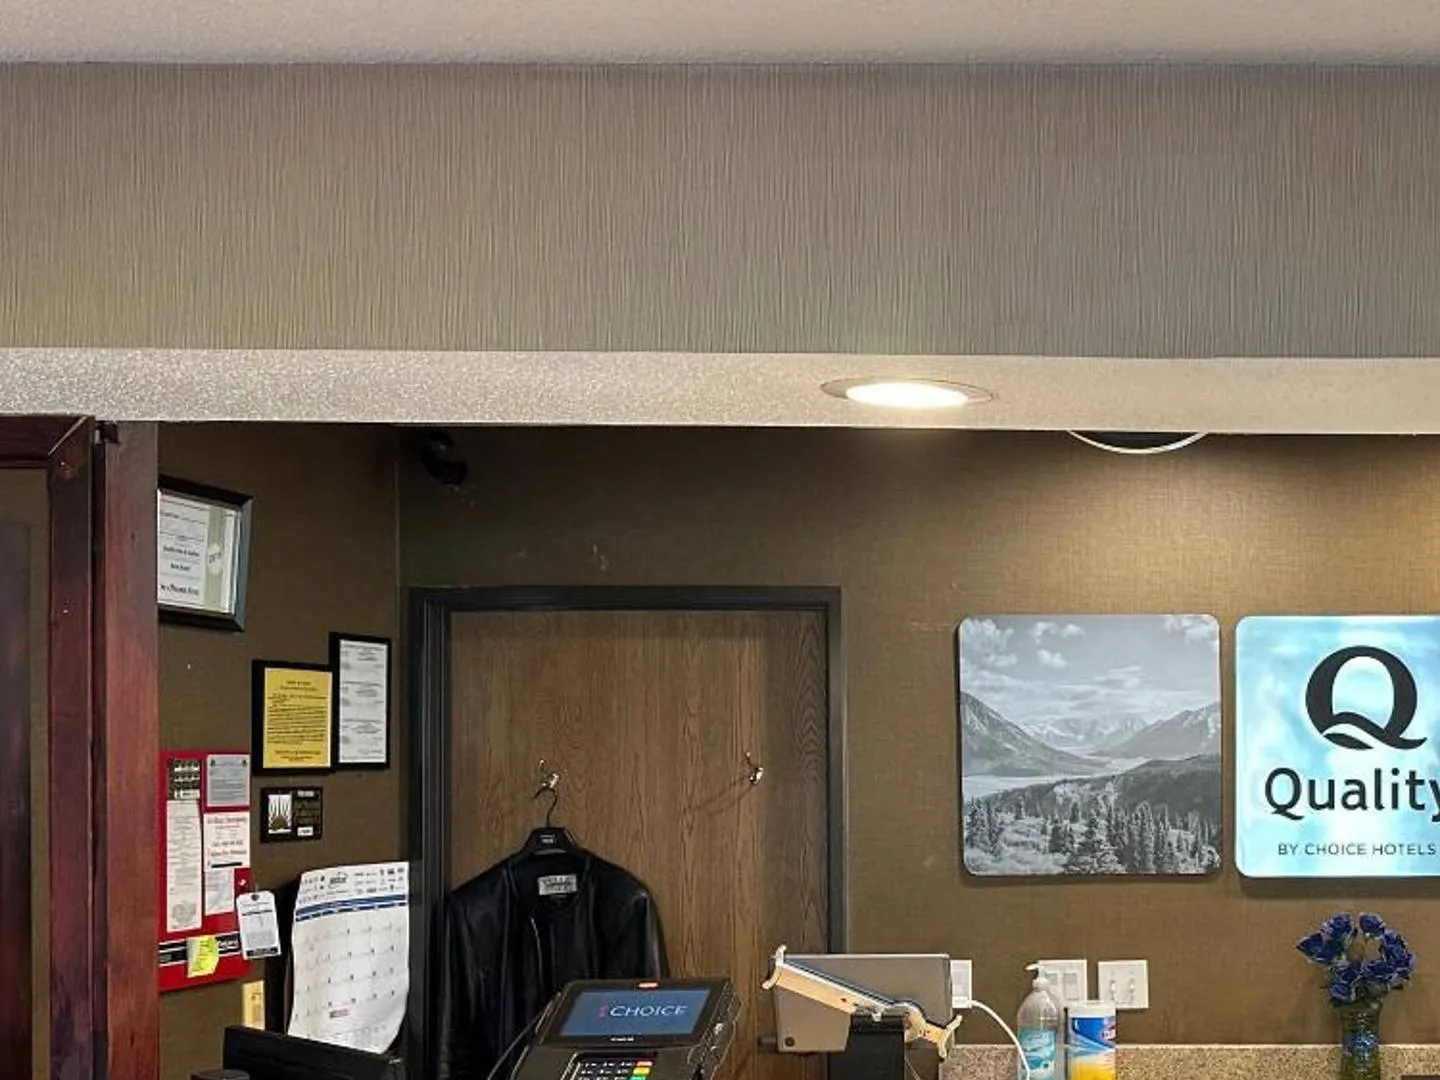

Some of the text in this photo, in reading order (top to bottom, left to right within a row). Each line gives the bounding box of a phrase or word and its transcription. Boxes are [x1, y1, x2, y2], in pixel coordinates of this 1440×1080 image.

[1305, 644, 1427, 751] Q
[1277, 842, 1437, 857] BY CHOICE HOTELS
[609, 1005, 689, 1018] CHOICE
